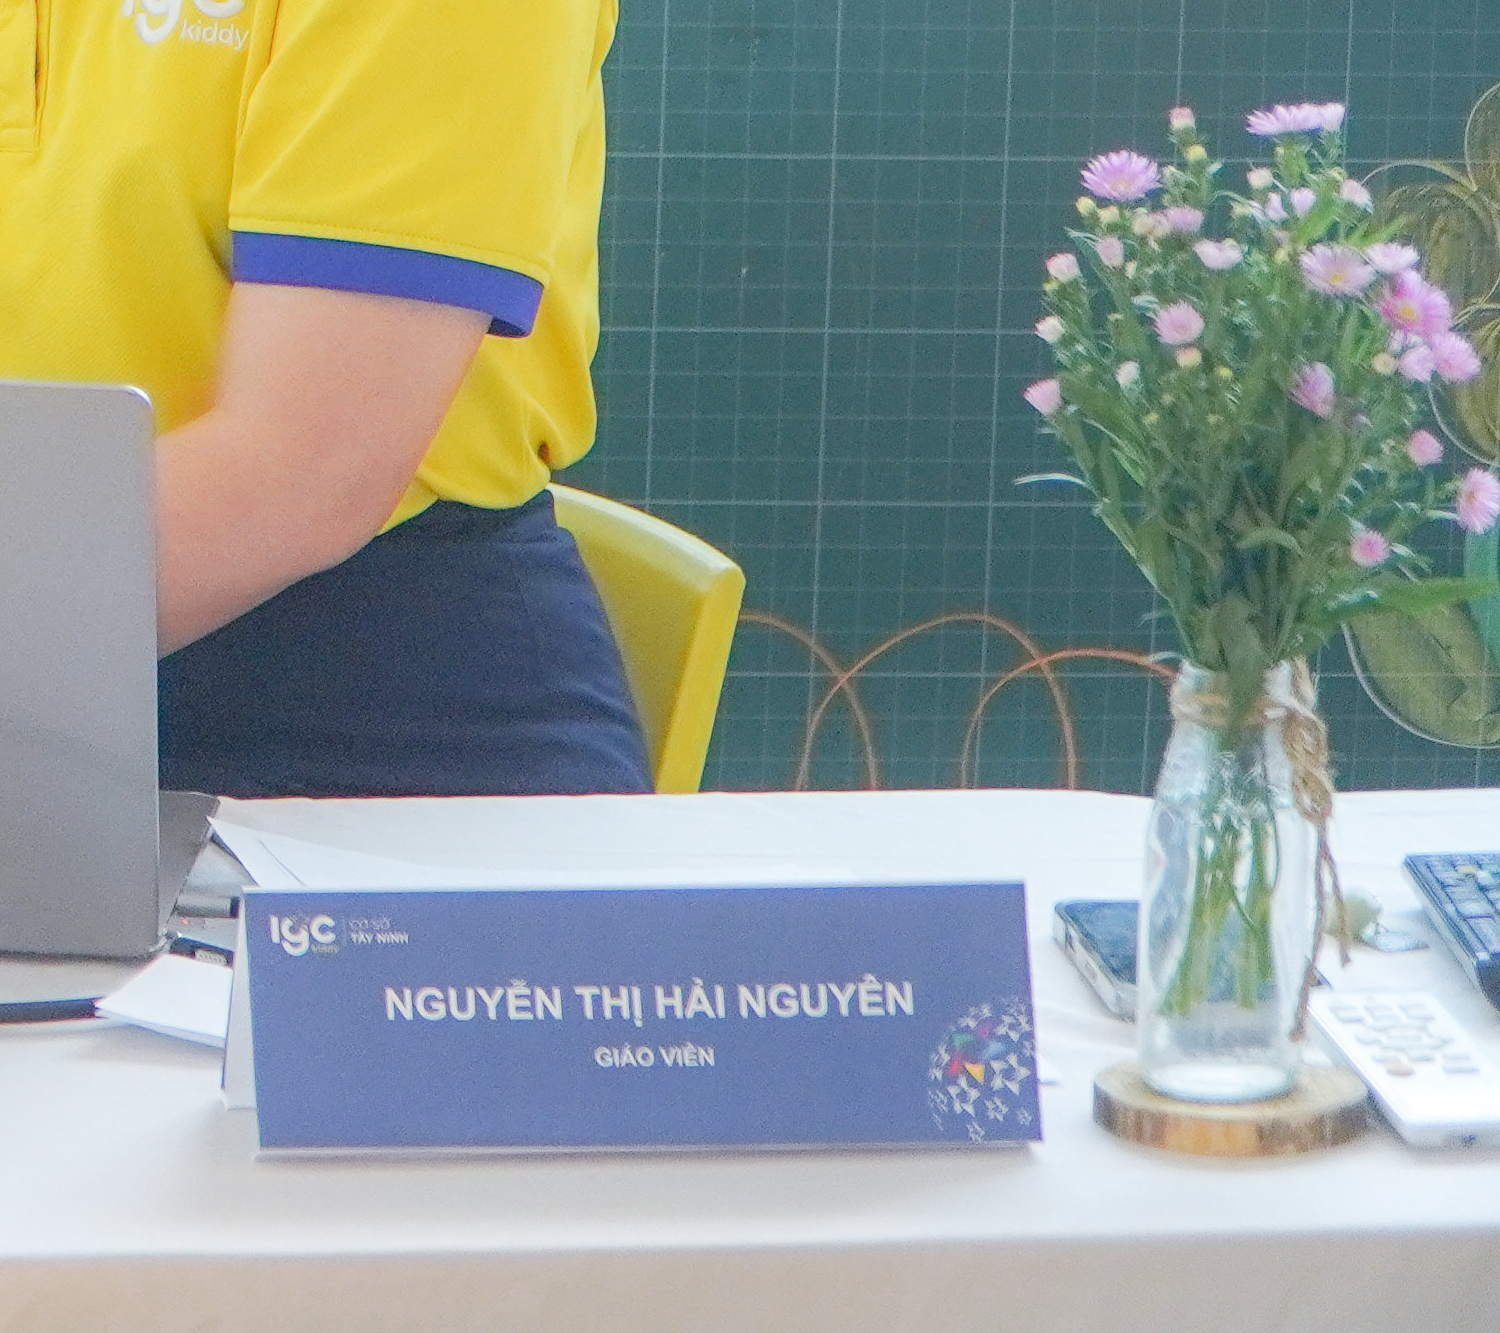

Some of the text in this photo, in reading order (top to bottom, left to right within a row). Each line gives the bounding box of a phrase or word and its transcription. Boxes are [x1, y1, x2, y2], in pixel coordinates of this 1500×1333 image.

[575, 984, 644, 1026] THỊ
[655, 977, 725, 1020] HẢI
[737, 973, 915, 1018] NGUYÊN
